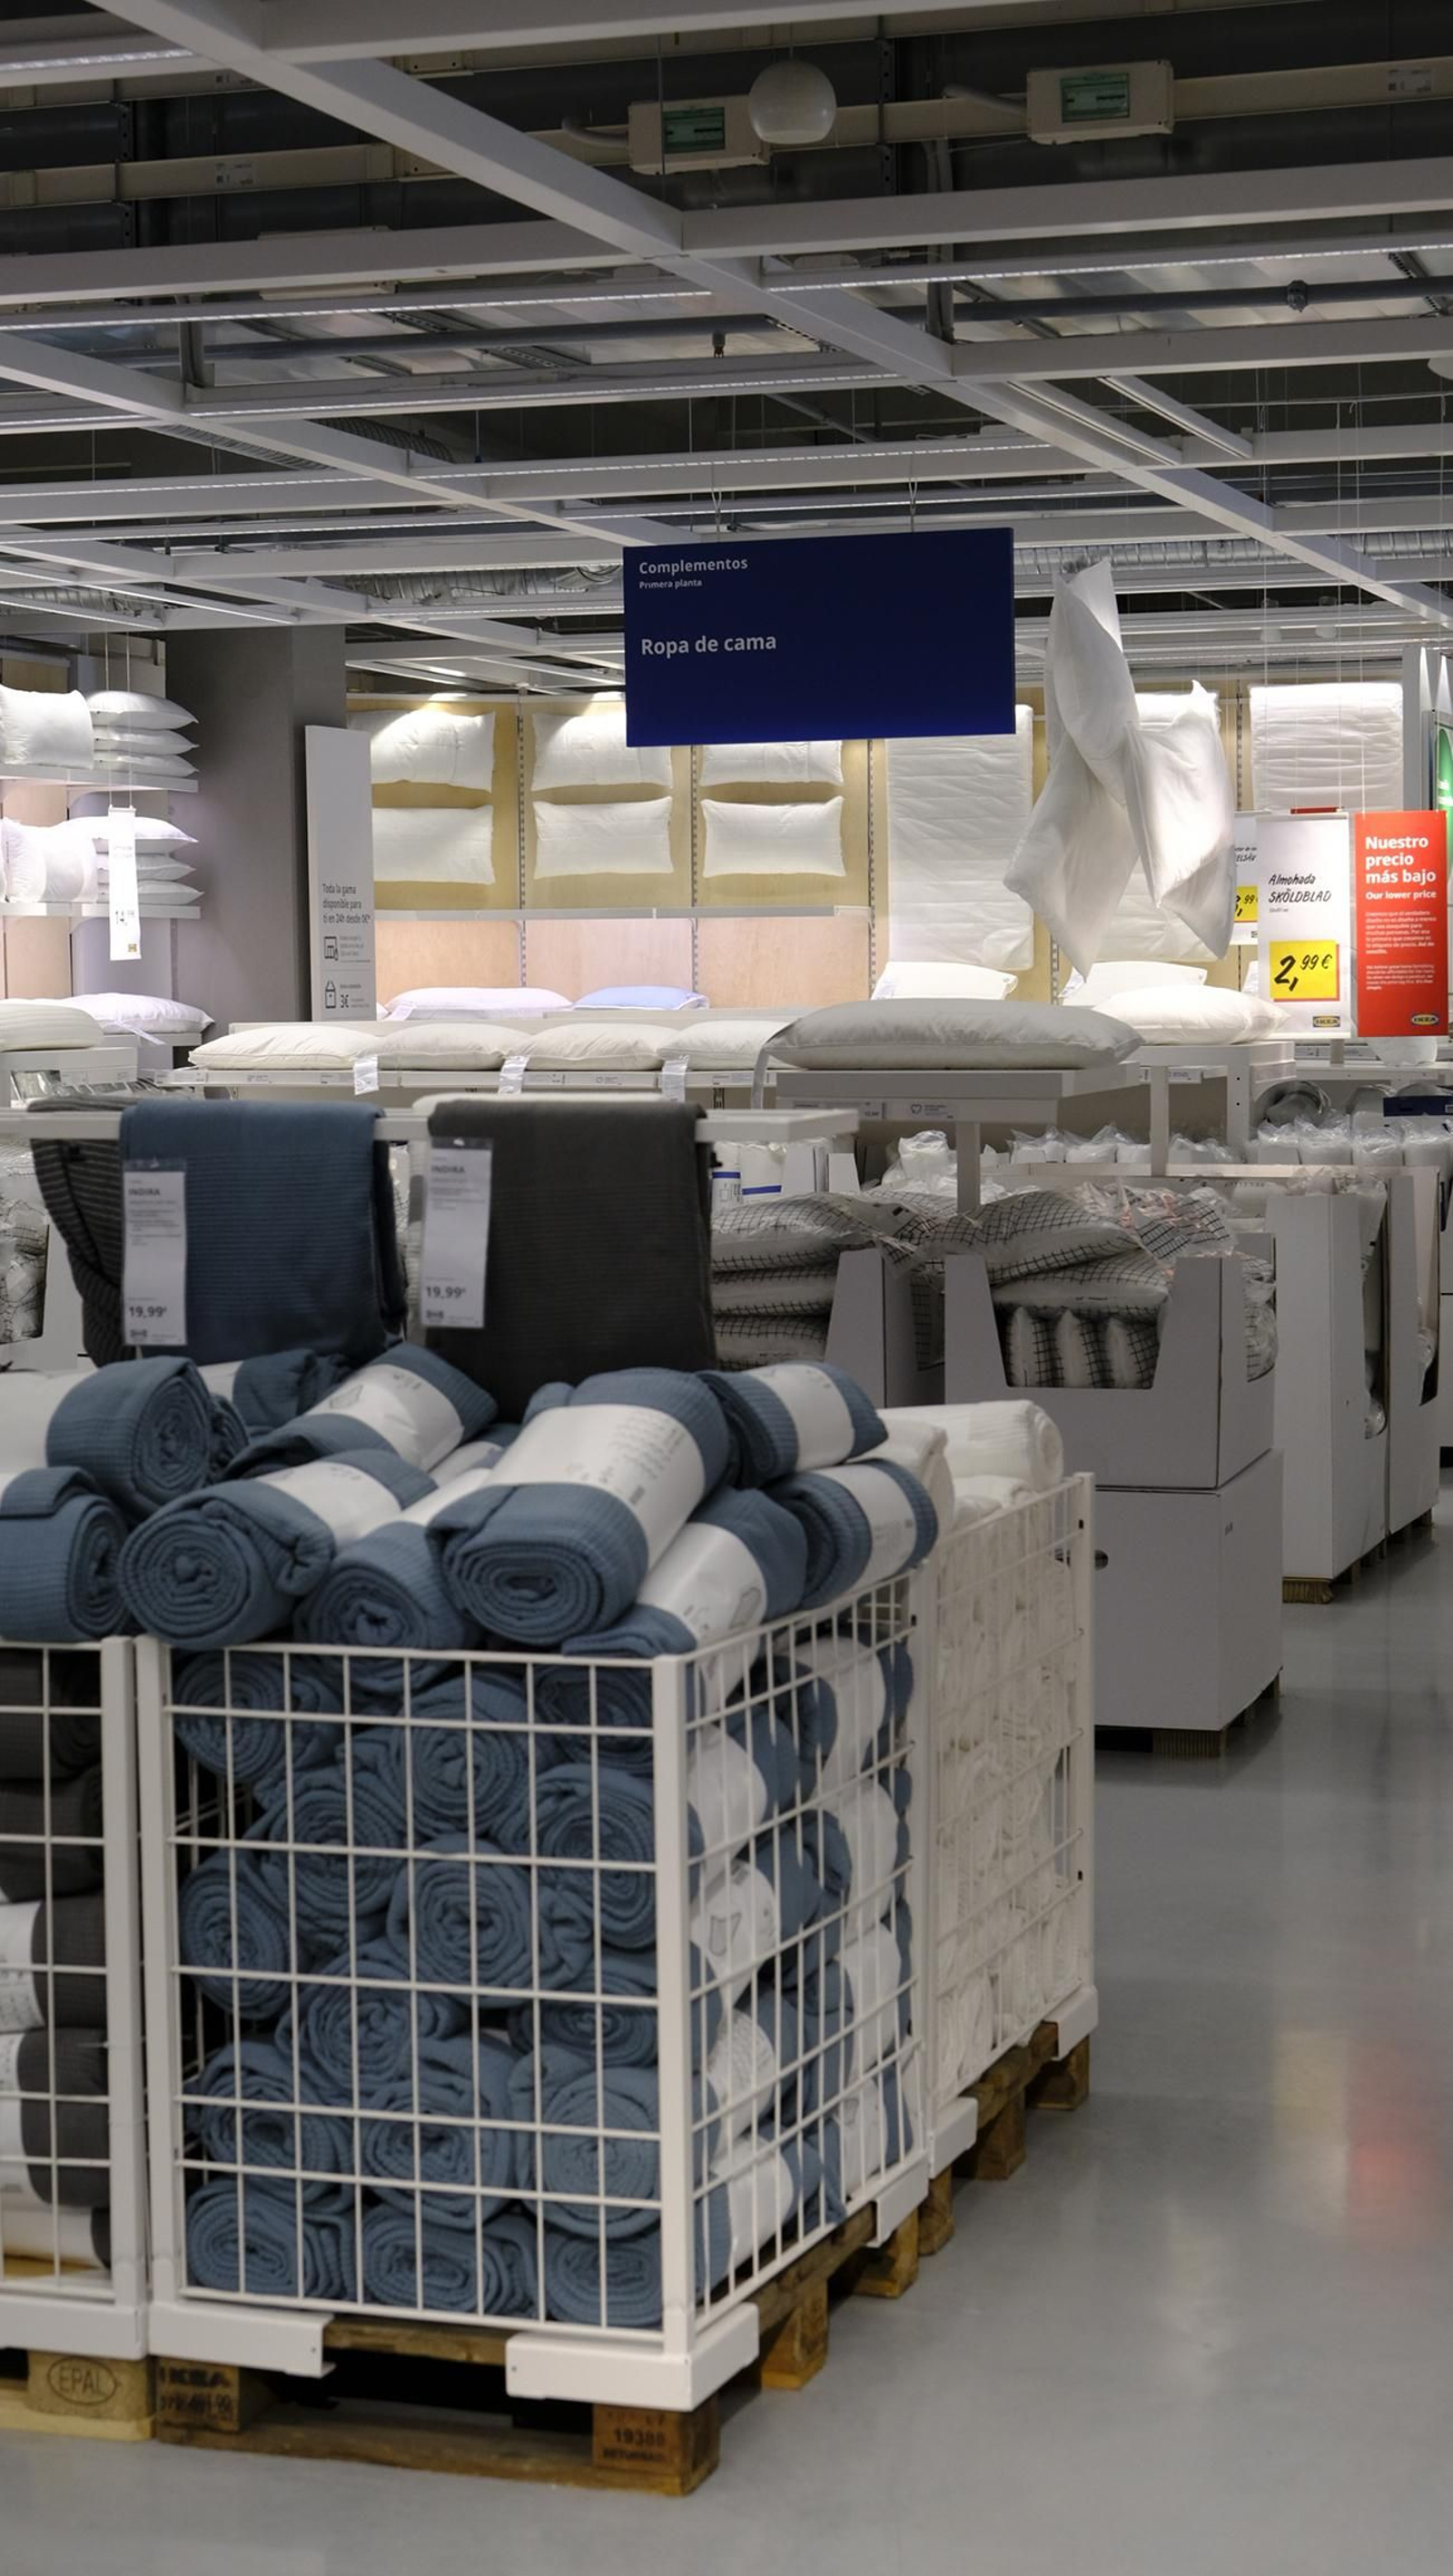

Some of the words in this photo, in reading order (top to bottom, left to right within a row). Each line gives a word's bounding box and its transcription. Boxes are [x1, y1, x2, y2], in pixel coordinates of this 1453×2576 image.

[639, 558, 748, 577] Complementos
[639, 581, 673, 589] Primera
[675, 579, 703, 590] planta
[641, 638, 689, 659] Ropa
[695, 635, 718, 653] de
[724, 636, 776, 652] cama
[1365, 836, 1428, 850] Nuestro
[1365, 852, 1414, 871] precio
[1268, 873, 1316, 886] Almohada
[1365, 869, 1399, 884] más
[1402, 868, 1437, 886] bajo
[1268, 888, 1332, 903] SKÖLDBLAD
[1365, 892, 1384, 900] Our
[1385, 891, 1411, 900] lower
[1412, 890, 1438, 901] price
[128, 1187, 161, 1197] INDIRA
